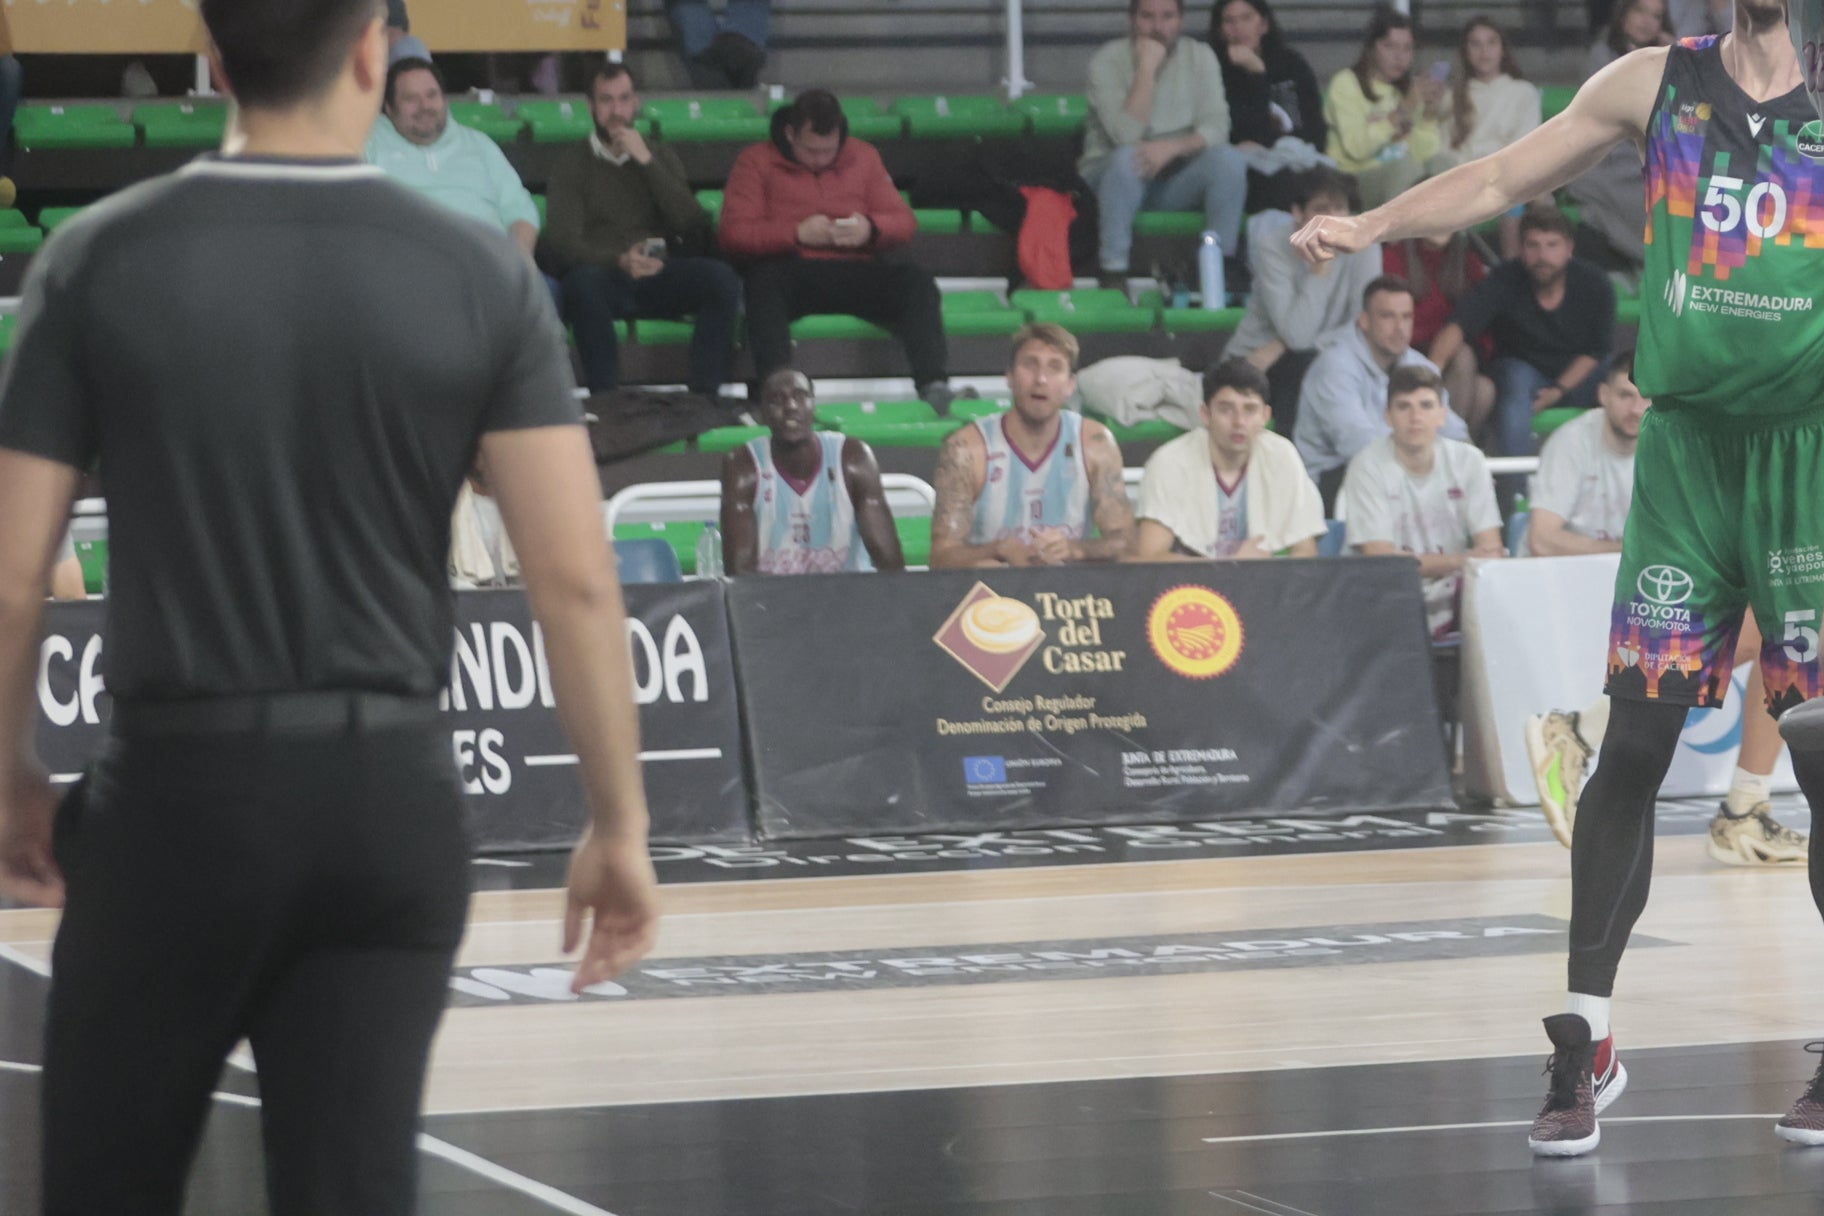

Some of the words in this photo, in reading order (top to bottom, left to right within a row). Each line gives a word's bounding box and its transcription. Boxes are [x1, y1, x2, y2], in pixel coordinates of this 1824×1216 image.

[1700, 175, 1787, 239] 50
[1689, 300, 1719, 313] NEW
[1720, 305, 1782, 322] ENERGIES
[1691, 285, 1813, 311] EXTREMADURA
[1034, 592, 1116, 620] Torta
[1629, 601, 1691, 622] TOYOTA
[1057, 617, 1102, 647] del
[1627, 616, 1692, 632] NOVOMOTOR
[1042, 646, 1127, 675] Casar
[981, 695, 1034, 715] Consejo
[1035, 694, 1097, 715] Regulador
[935, 715, 1025, 735] Denominación
[1026, 715, 1042, 732] de
[1044, 714, 1088, 734] Origen
[1089, 711, 1147, 733] Protegida
[640, 926, 1564, 979] EXTREMADURA
